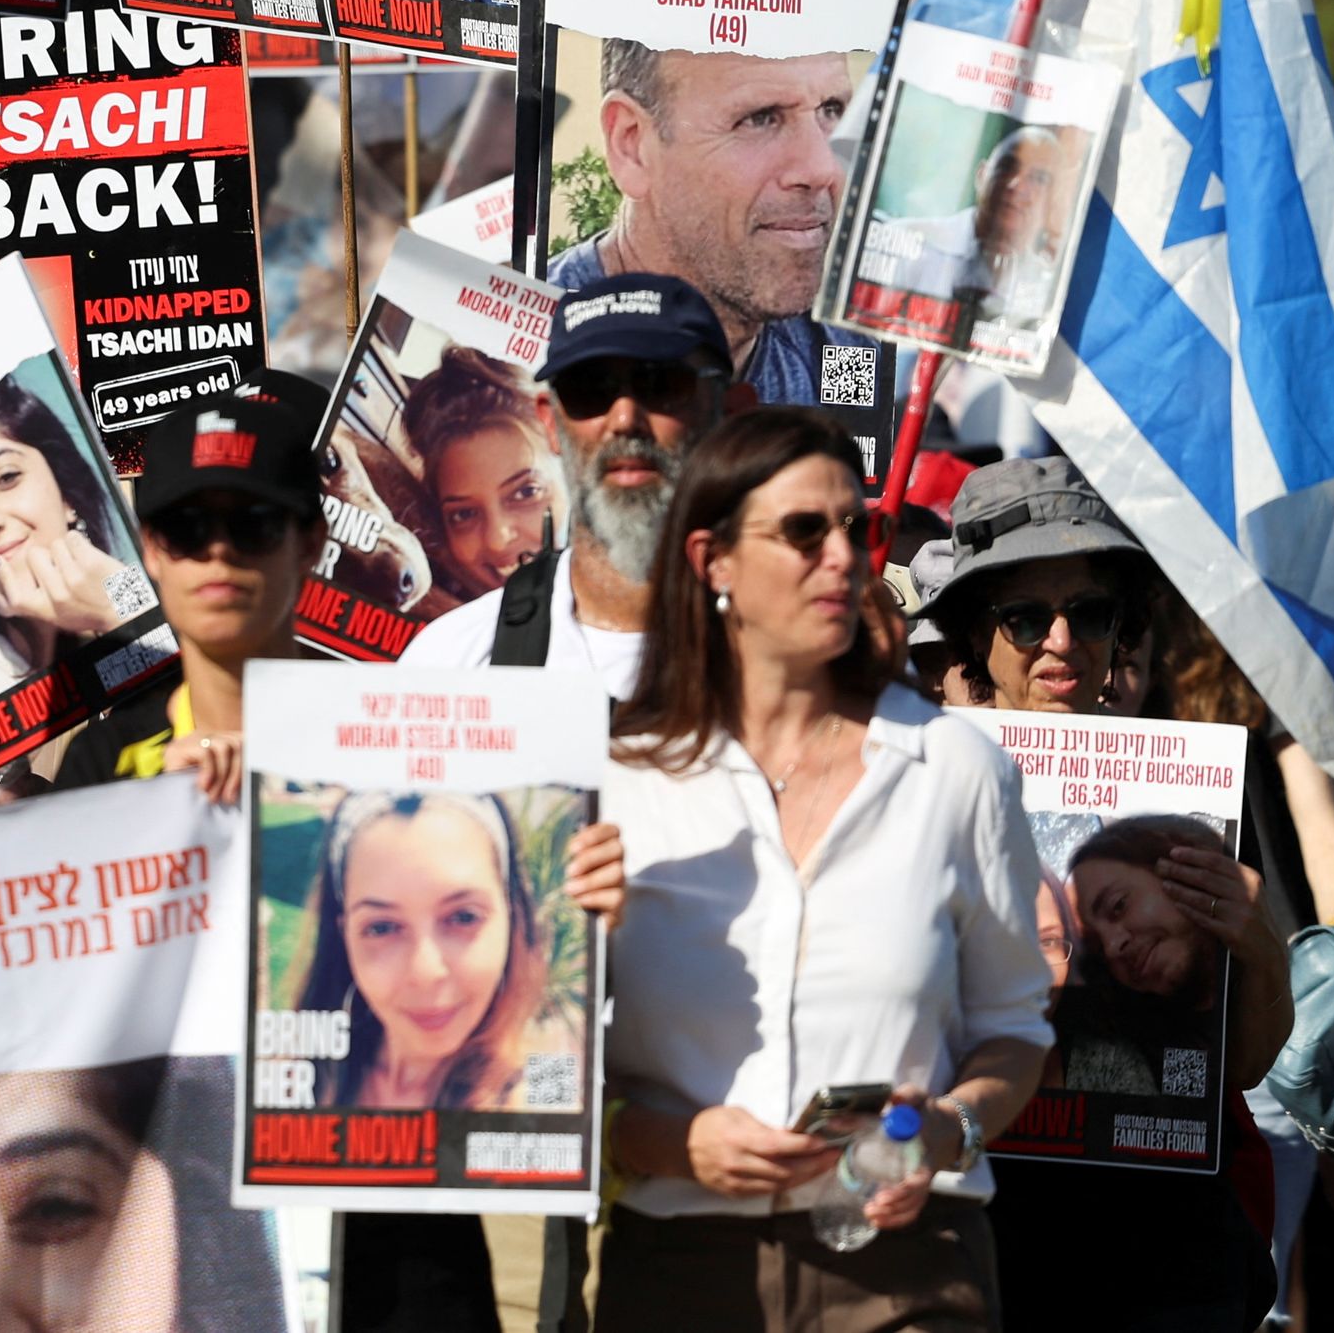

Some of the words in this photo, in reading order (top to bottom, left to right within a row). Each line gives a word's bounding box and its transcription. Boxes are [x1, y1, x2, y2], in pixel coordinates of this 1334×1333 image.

[251, 0, 288, 20] FAMILIES
[289, 5, 320, 24] FORUM
[461, 27, 495, 49] FAMILIES
[710, 12, 747, 47] (49)
[865, 220, 924, 260] BRING
[129, 257, 167, 290] עידן
[171, 254, 199, 283] צחי
[490, 275, 518, 299] ינאי
[84, 289, 250, 325] KIDNAPPED
[457, 287, 514, 325] MORAN
[514, 309, 551, 341] STEL
[567, 302, 608, 331] HOME
[87, 327, 183, 358] TSACHI
[188, 322, 254, 351] IDAN
[505, 333, 541, 363] (40)
[102, 395, 130, 416] 49
[133, 384, 193, 414] years
[198, 373, 231, 399] old
[337, 725, 400, 749] MORAN
[406, 725, 458, 750] STELA
[464, 727, 516, 751] YANAI
[999, 725, 1055, 748] בוכשטב
[1061, 729, 1089, 751] ויגב
[1095, 732, 1145, 758] קירשט
[1151, 736, 1186, 758] רימון
[407, 756, 444, 782] (40)
[1059, 757, 1089, 778] AND
[1095, 758, 1141, 782] YAGEV
[1146, 762, 1233, 789] BUCHSHTAB
[1062, 781, 1117, 810] (36,34)
[95, 845, 209, 909] ראשון
[131, 893, 213, 949] אתם
[256, 1009, 351, 1060] BRING
[254, 1059, 315, 1109] HER
[252, 1113, 341, 1163] HOME
[347, 1109, 437, 1164] NOW!
[1115, 1114, 1154, 1129] HOSTAGES
[1156, 1117, 1171, 1131] AND
[1172, 1119, 1207, 1134] MISSING
[1114, 1128, 1164, 1150] FAMILIES
[1166, 1132, 1206, 1154] FORUM
